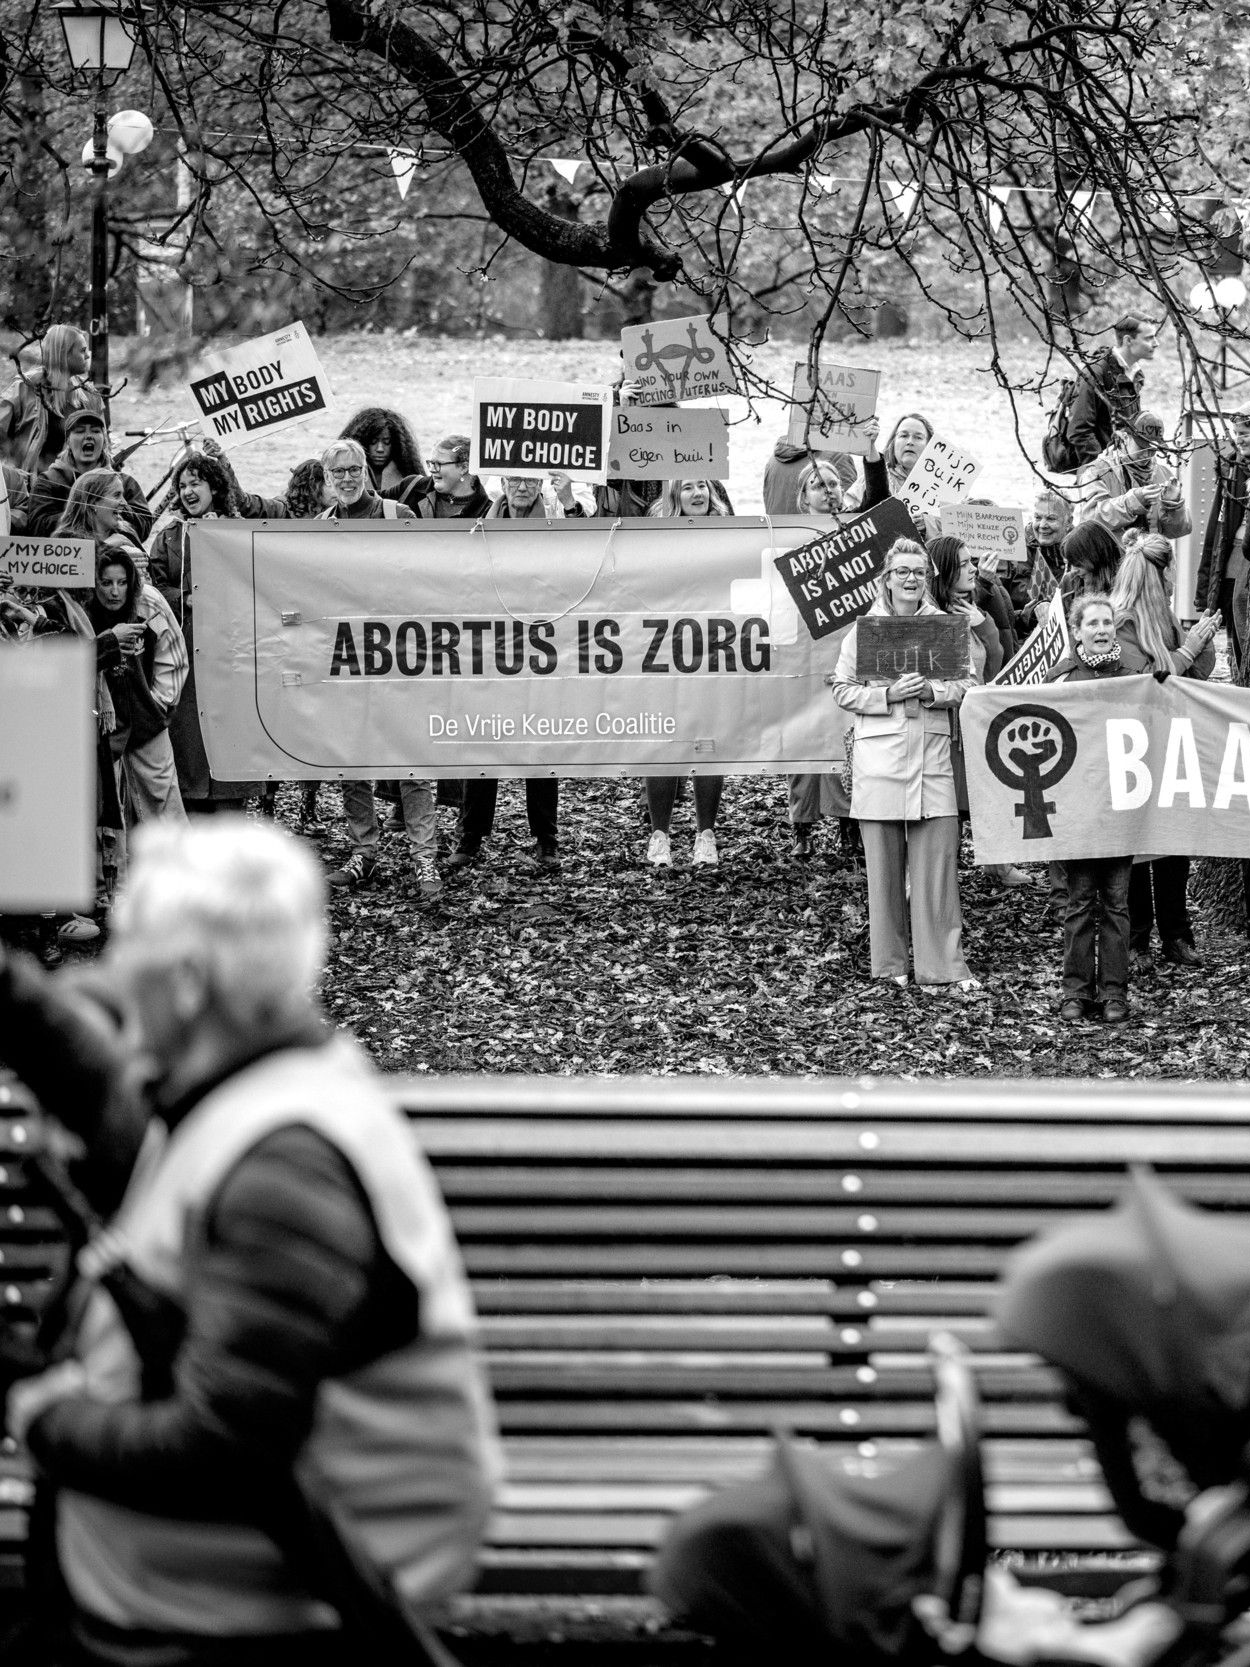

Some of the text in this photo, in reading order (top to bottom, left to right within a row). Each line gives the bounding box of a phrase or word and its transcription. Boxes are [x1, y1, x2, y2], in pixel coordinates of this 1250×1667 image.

[199, 360, 283, 407] MY BODY
[660, 370, 690, 386] YOUR
[694, 369, 719, 380] OWN
[685, 382, 726, 397] UTERUS
[212, 383, 316, 436] MY RIGHTS
[486, 405, 578, 433] MY BODY
[617, 414, 682, 434] Baas in
[484, 438, 597, 468] MY CHOICE
[629, 448, 664, 468] eigen
[15, 543, 40, 556] MY
[789, 517, 878, 577] ABORTION
[8, 561, 30, 574] MY
[800, 550, 875, 602] IS A NOT
[814, 577, 881, 627] A CRIM
[330, 617, 771, 677] ABORTUS IS ZORG
[1049, 632, 1062, 667] MY
[429, 712, 676, 740] De Vrije Keuze Coalitie
